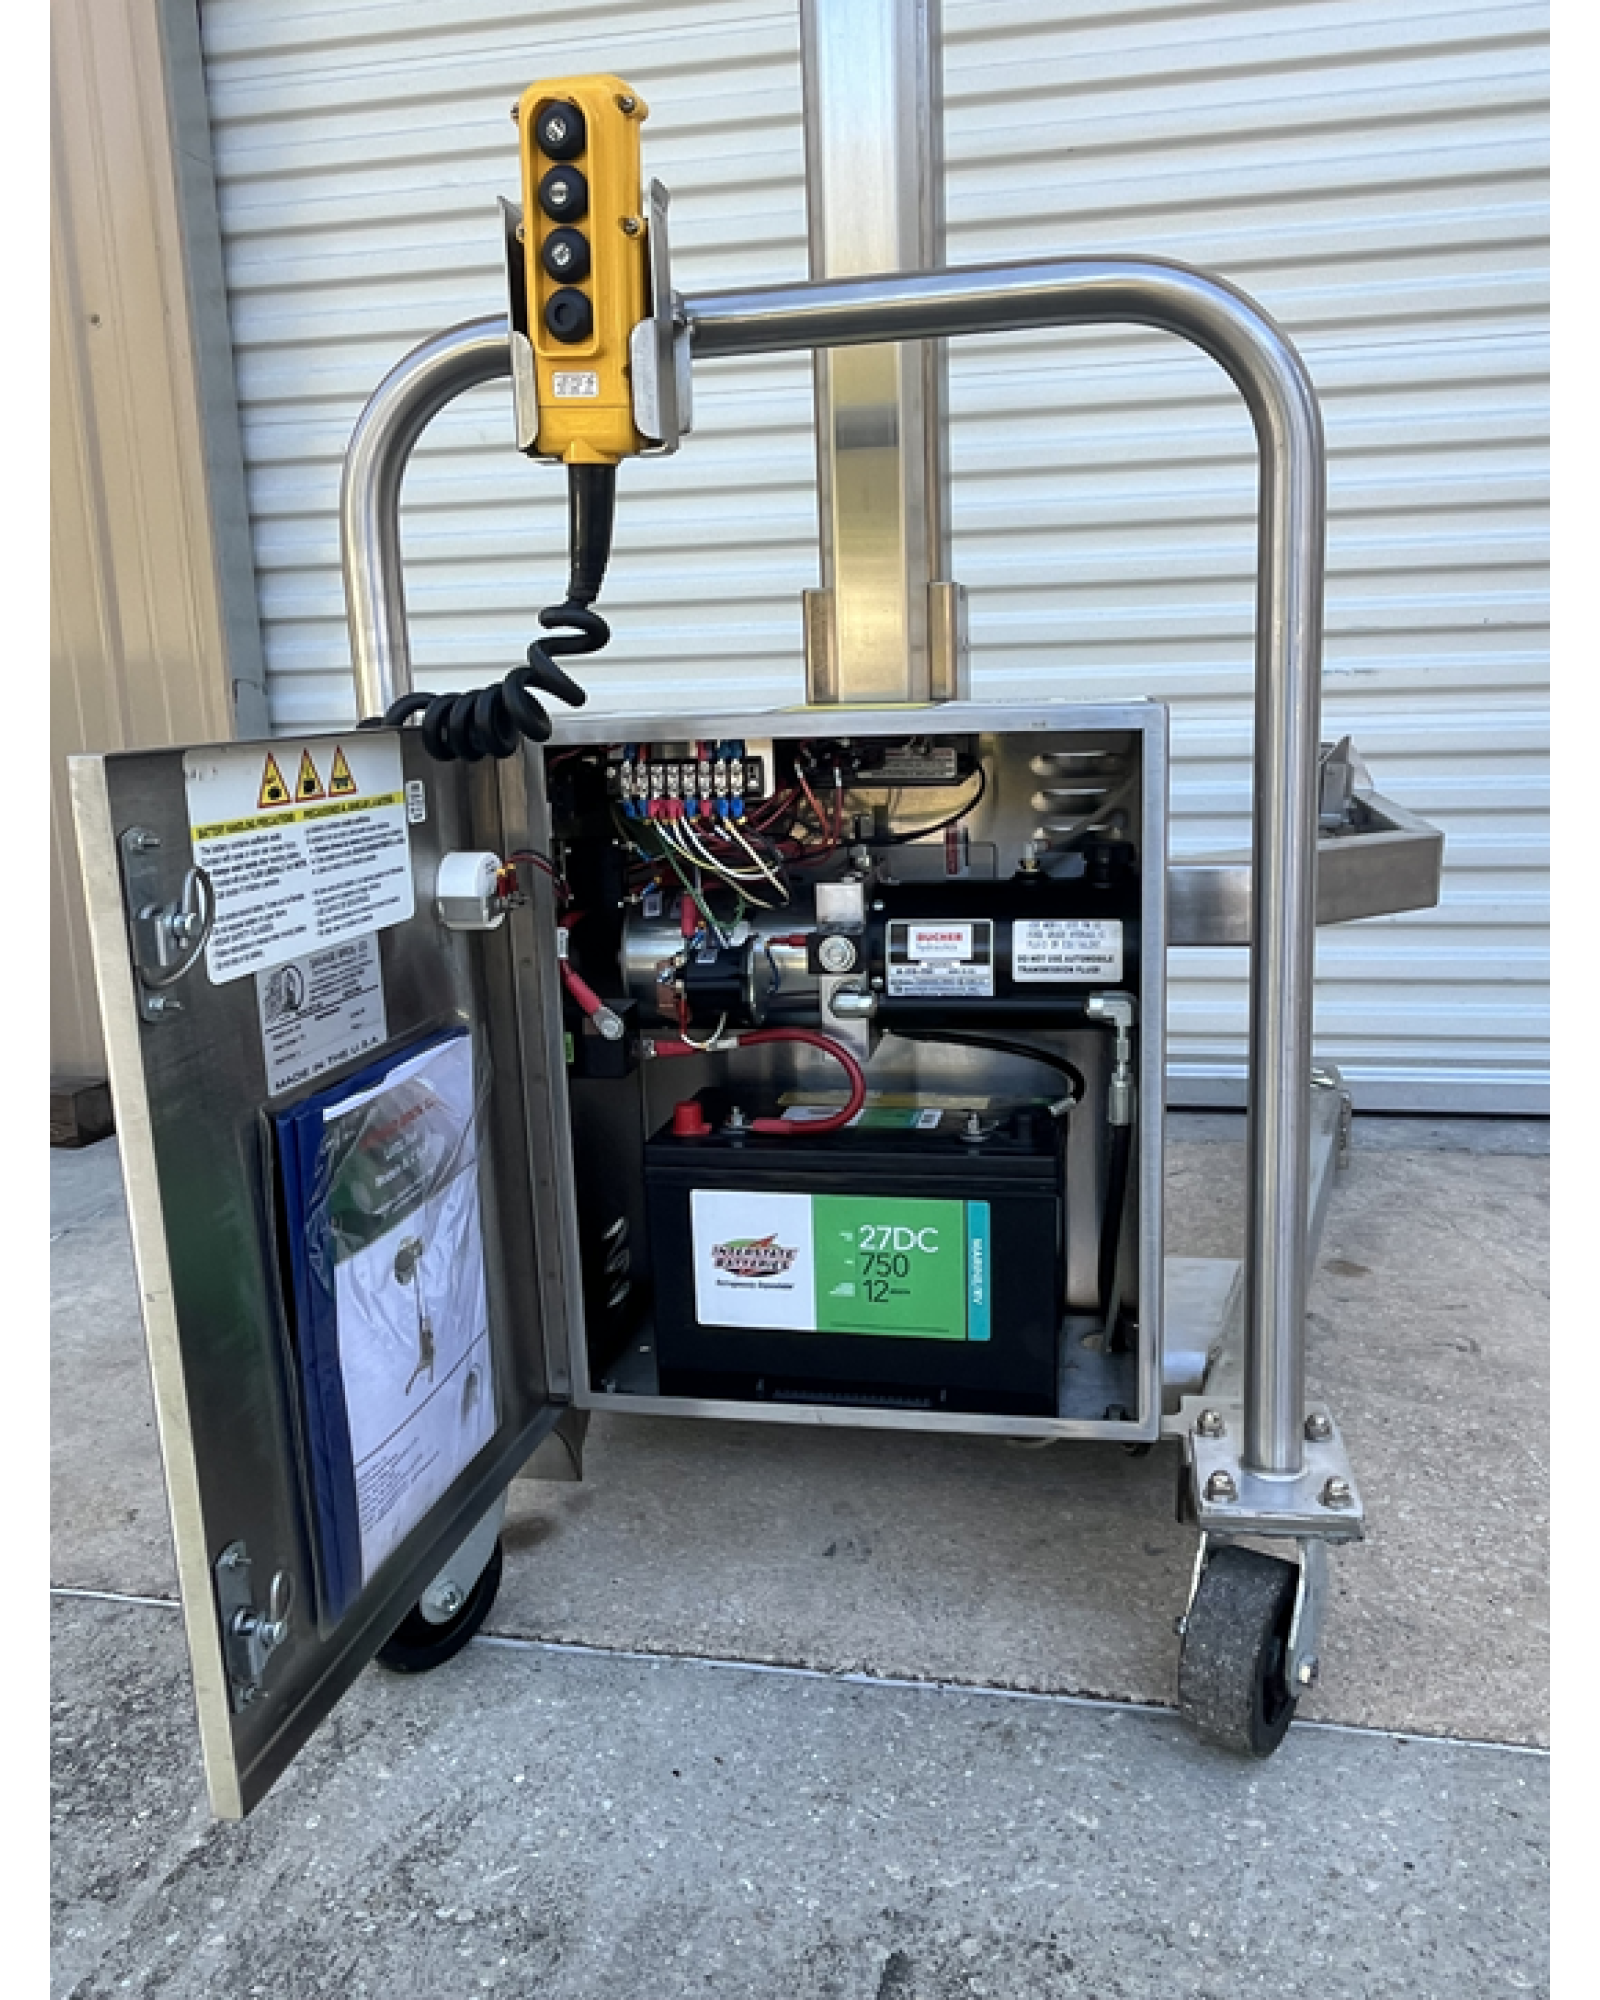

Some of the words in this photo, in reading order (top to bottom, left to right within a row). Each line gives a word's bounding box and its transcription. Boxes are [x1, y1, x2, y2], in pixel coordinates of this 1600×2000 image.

[916, 932, 963, 942] BUCHER
[859, 1224, 939, 1253] 27DC
[860, 1251, 910, 1278] 750
[863, 1279, 890, 1303] 12
